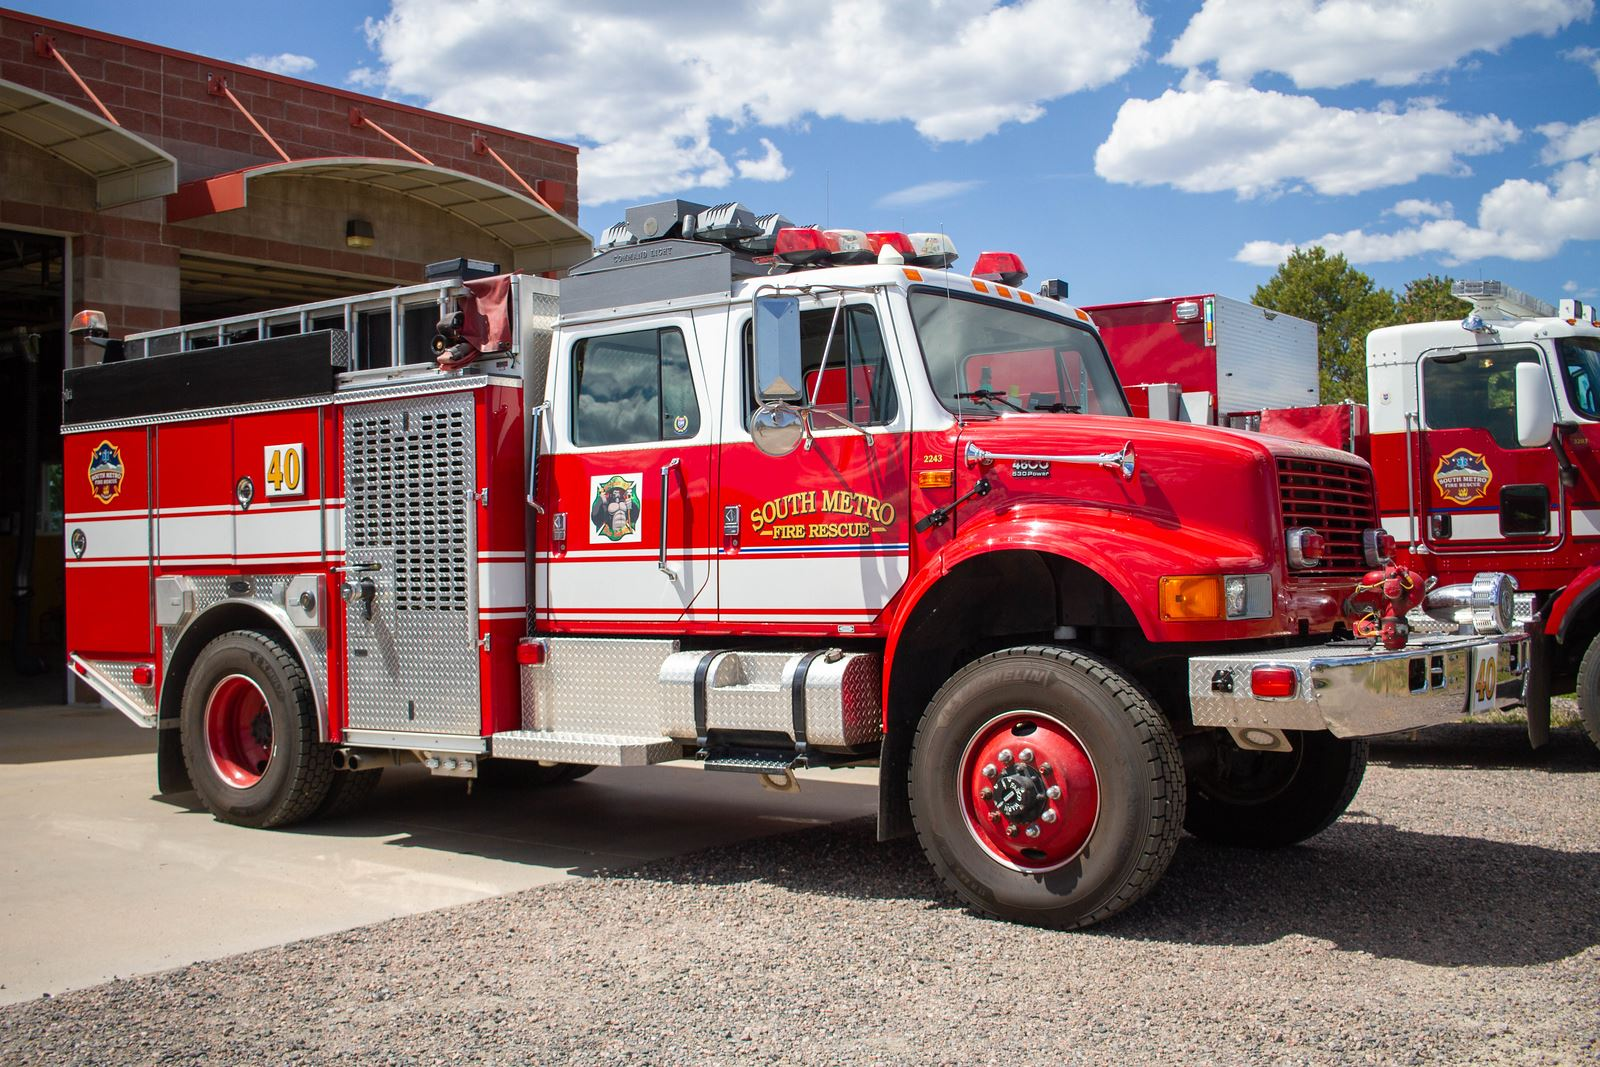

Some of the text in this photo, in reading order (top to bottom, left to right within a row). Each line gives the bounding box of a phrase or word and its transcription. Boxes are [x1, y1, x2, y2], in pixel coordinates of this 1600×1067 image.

[613, 246, 673, 264] COMMAND LIGHT
[923, 454, 943, 463] 2243
[267, 447, 300, 491] 40
[1439, 476, 1461, 484] SOUTH
[750, 489, 896, 532] SOUTH METRO
[772, 522, 870, 540] FIRE RESCUE
[1475, 656, 1496, 702] 40
